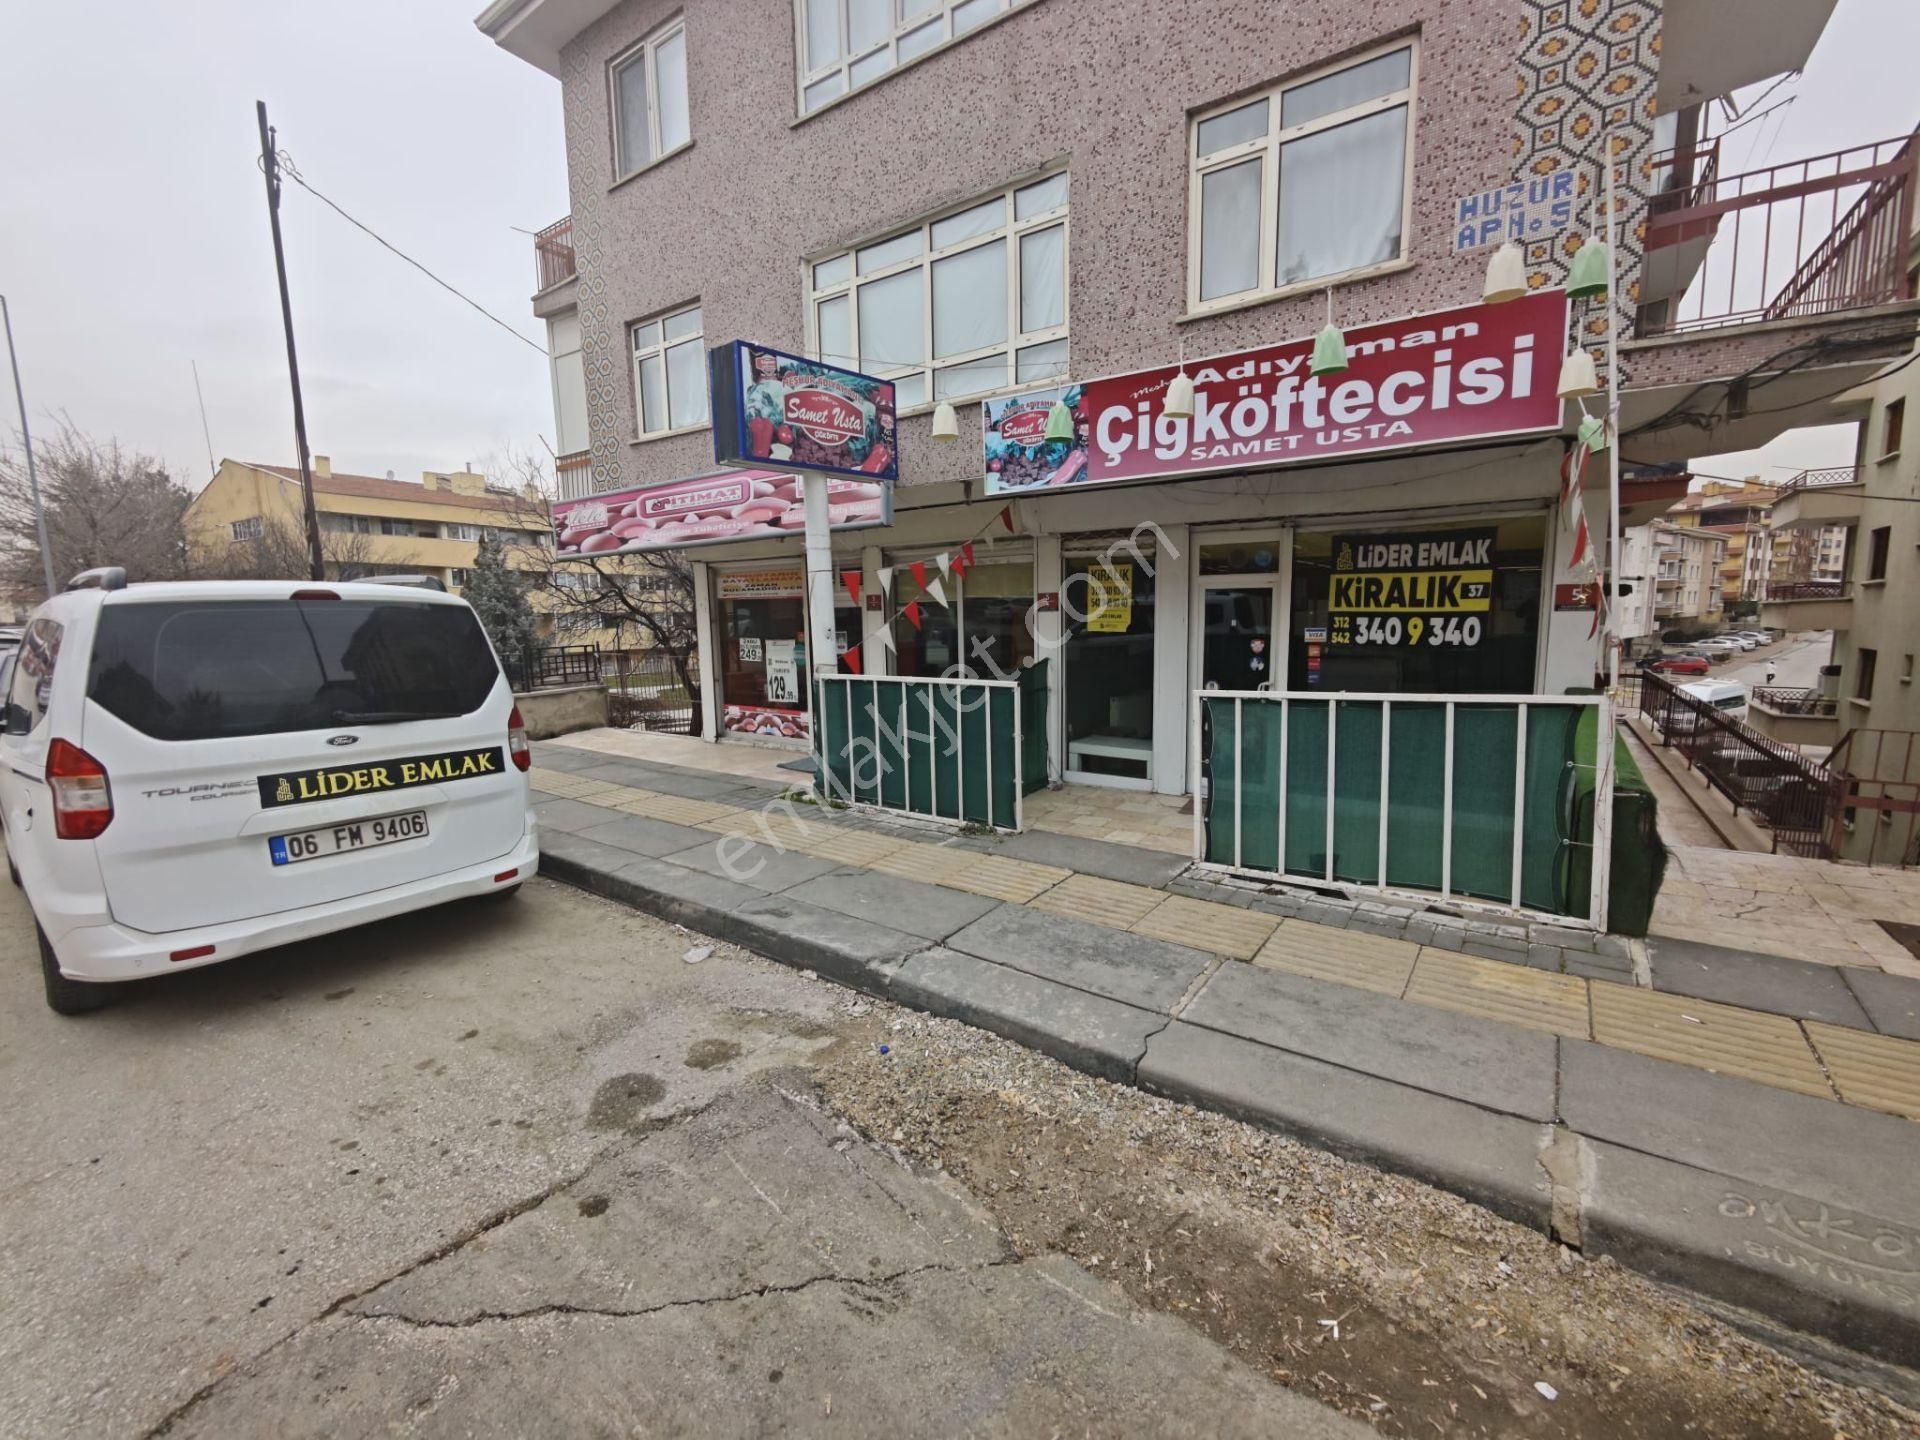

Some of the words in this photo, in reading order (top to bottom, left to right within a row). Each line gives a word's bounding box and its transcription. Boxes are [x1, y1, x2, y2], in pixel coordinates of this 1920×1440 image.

[1459, 170, 1574, 223] HUZUR
[1192, 321, 1480, 386] Adıyman
[787, 397, 829, 425] Samet
[831, 407, 863, 432] Usta
[1003, 422, 1034, 437] Samet
[1190, 434, 1304, 461] SAMET
[1315, 420, 1414, 446] USTA
[1417, 538, 1493, 567] EMLAK
[1468, 584, 1484, 598] 37
[1331, 631, 1350, 644] 542
[1333, 616, 1350, 629] 312
[1354, 616, 1402, 645] 340
[1407, 616, 1424, 645] 9
[1428, 616, 1481, 646] 340
[297, 766, 396, 800] LİDER
[400, 752, 497, 785] EMLAK
[288, 833, 319, 858] 06
[334, 826, 365, 850] FM
[374, 814, 426, 842] 9406
[274, 851, 287, 860] TR
